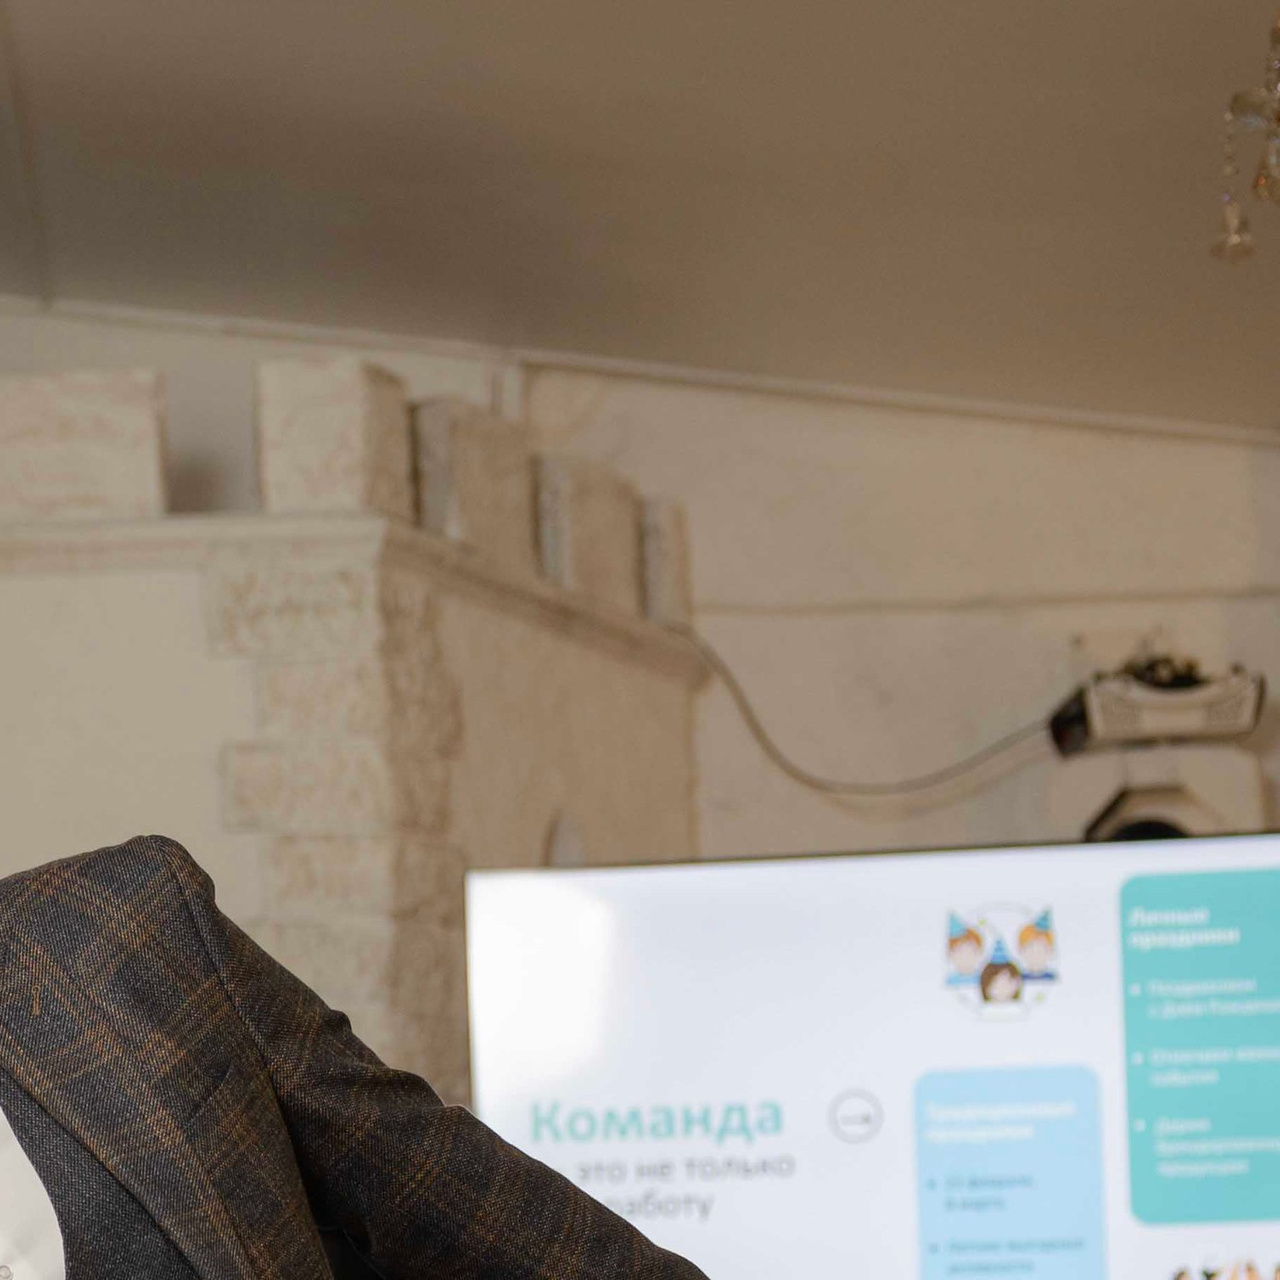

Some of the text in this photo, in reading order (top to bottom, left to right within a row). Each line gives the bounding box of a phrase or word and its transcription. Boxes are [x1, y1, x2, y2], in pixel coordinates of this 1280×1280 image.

[530, 1098, 785, 1144] Команда
[578, 1153, 797, 1184] это не только
